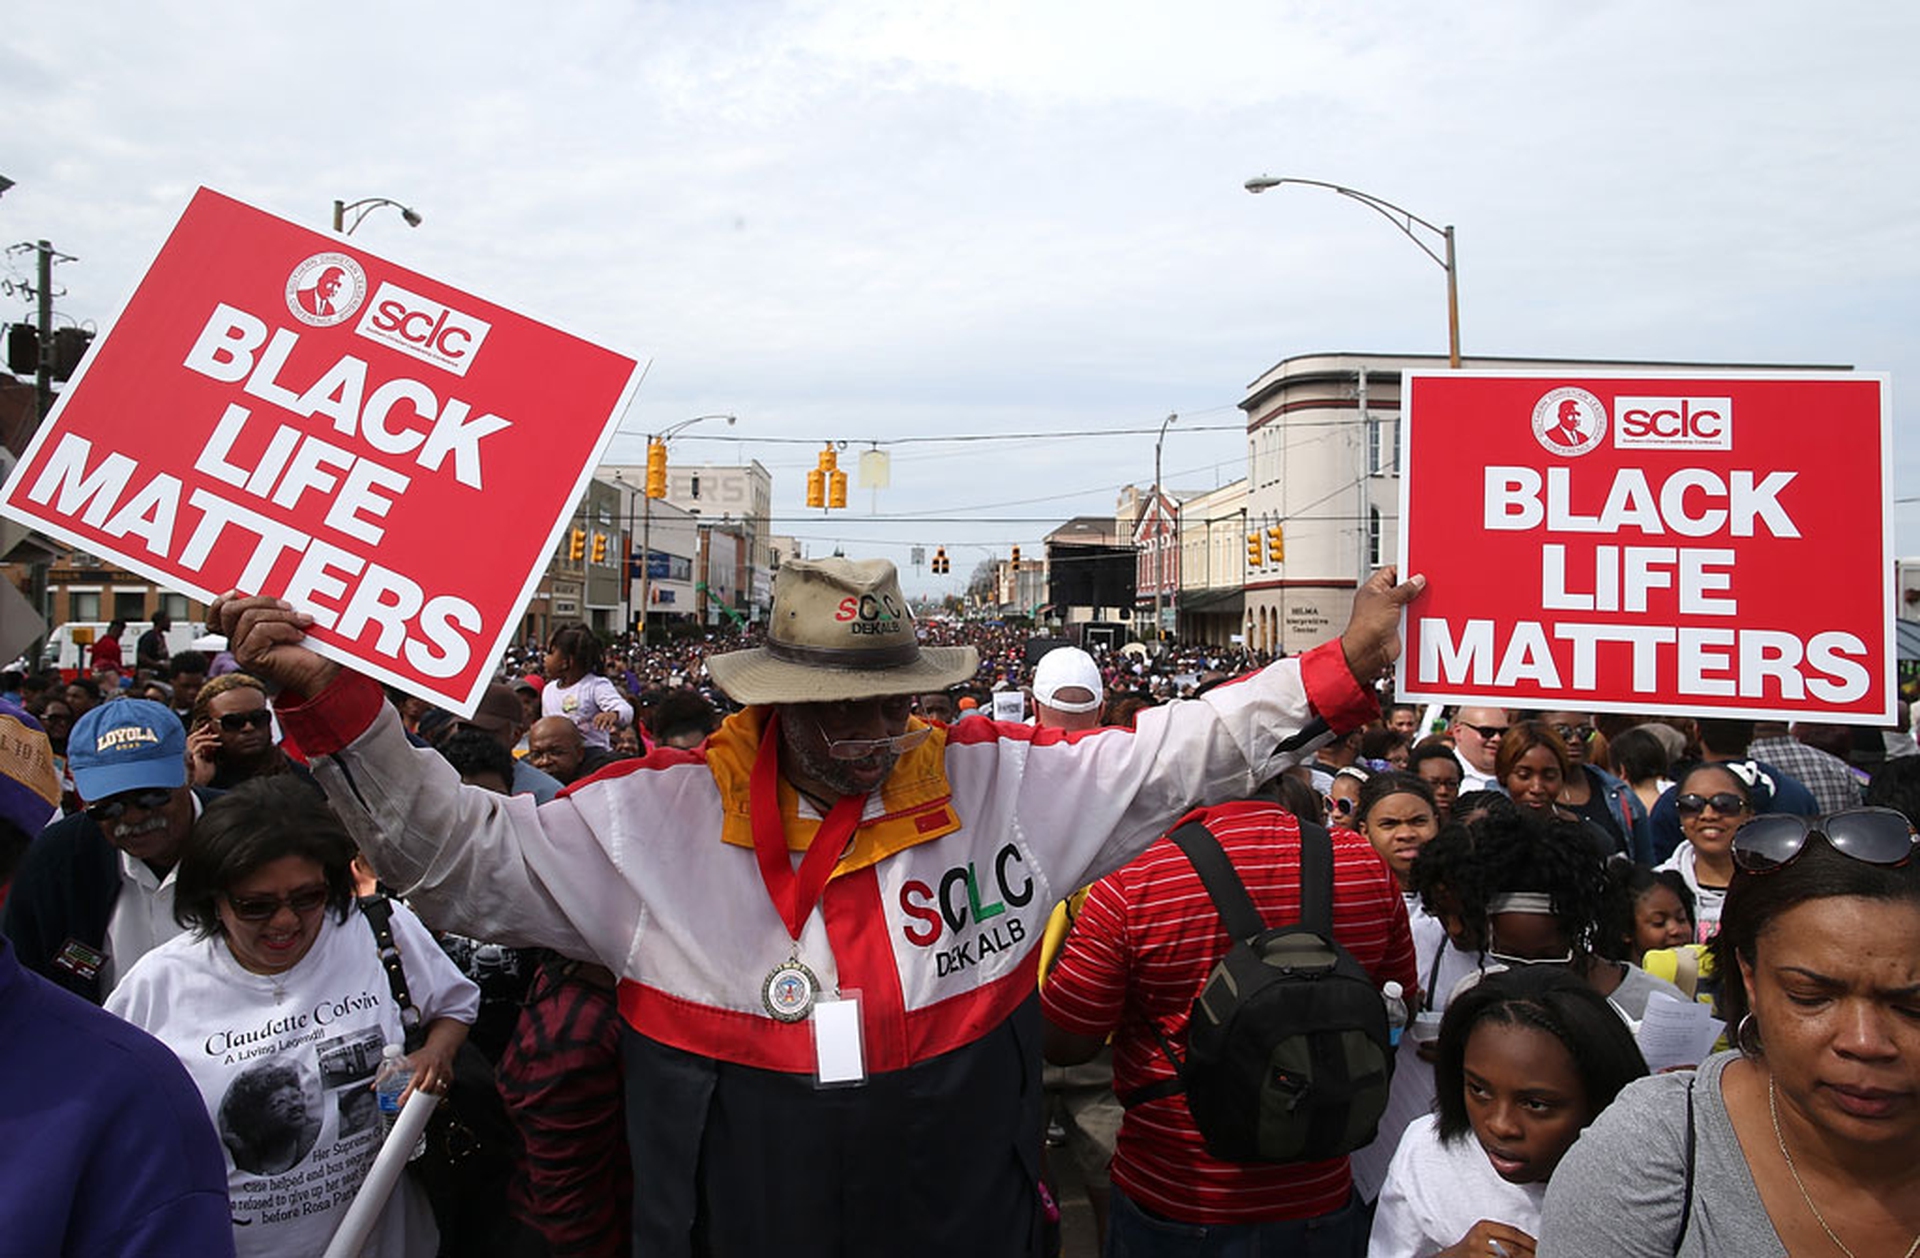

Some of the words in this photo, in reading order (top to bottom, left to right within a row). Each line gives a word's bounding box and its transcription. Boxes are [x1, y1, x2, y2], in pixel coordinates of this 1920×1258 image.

[183, 303, 513, 491] BLACK
[195, 402, 411, 546] LIFE
[1484, 465, 1802, 538] BLACK
[27, 432, 482, 679] MATTERS
[1542, 543, 1737, 616] LIFE
[835, 594, 901, 622] SCLC
[852, 621, 901, 635] DEKALB
[1419, 617, 1871, 704] MATTERS
[97, 727, 159, 751] LOYOLA
[900, 843, 1034, 947] SCLC
[936, 918, 1026, 978] DEKALB
[205, 1013, 309, 1057] Claudette
[314, 991, 380, 1027] Colvin
[224, 1054, 235, 1066] A
[239, 1043, 277, 1062] Living
[238, 1194, 274, 1210] refused
[276, 1193, 290, 1207] to
[262, 1206, 300, 1225] before
[303, 1198, 331, 1216] Rosa
